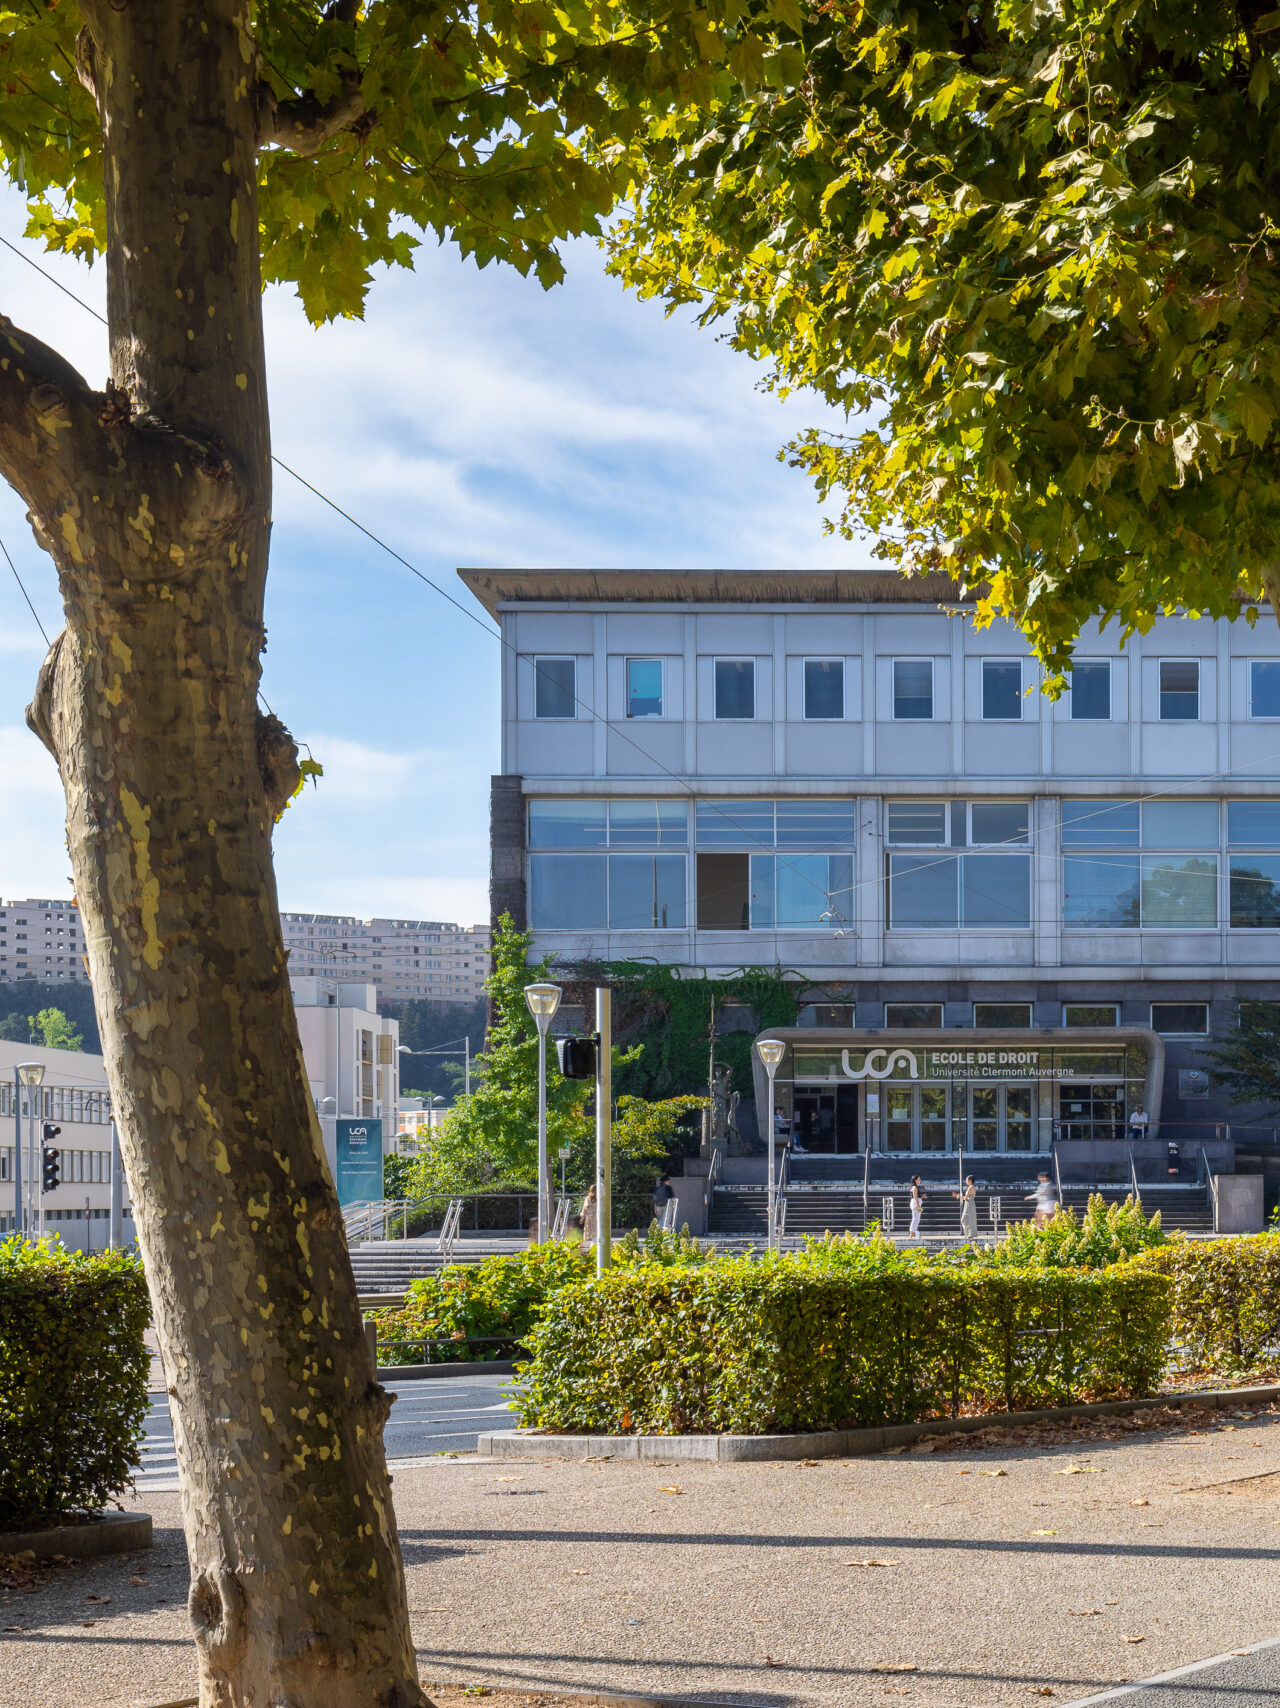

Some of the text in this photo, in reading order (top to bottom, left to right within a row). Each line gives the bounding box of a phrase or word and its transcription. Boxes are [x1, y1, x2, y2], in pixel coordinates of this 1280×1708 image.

[931, 1052, 1039, 1064] ECOLE DE DROIT
[931, 1066, 1075, 1079] Université Clermont Auvergne
